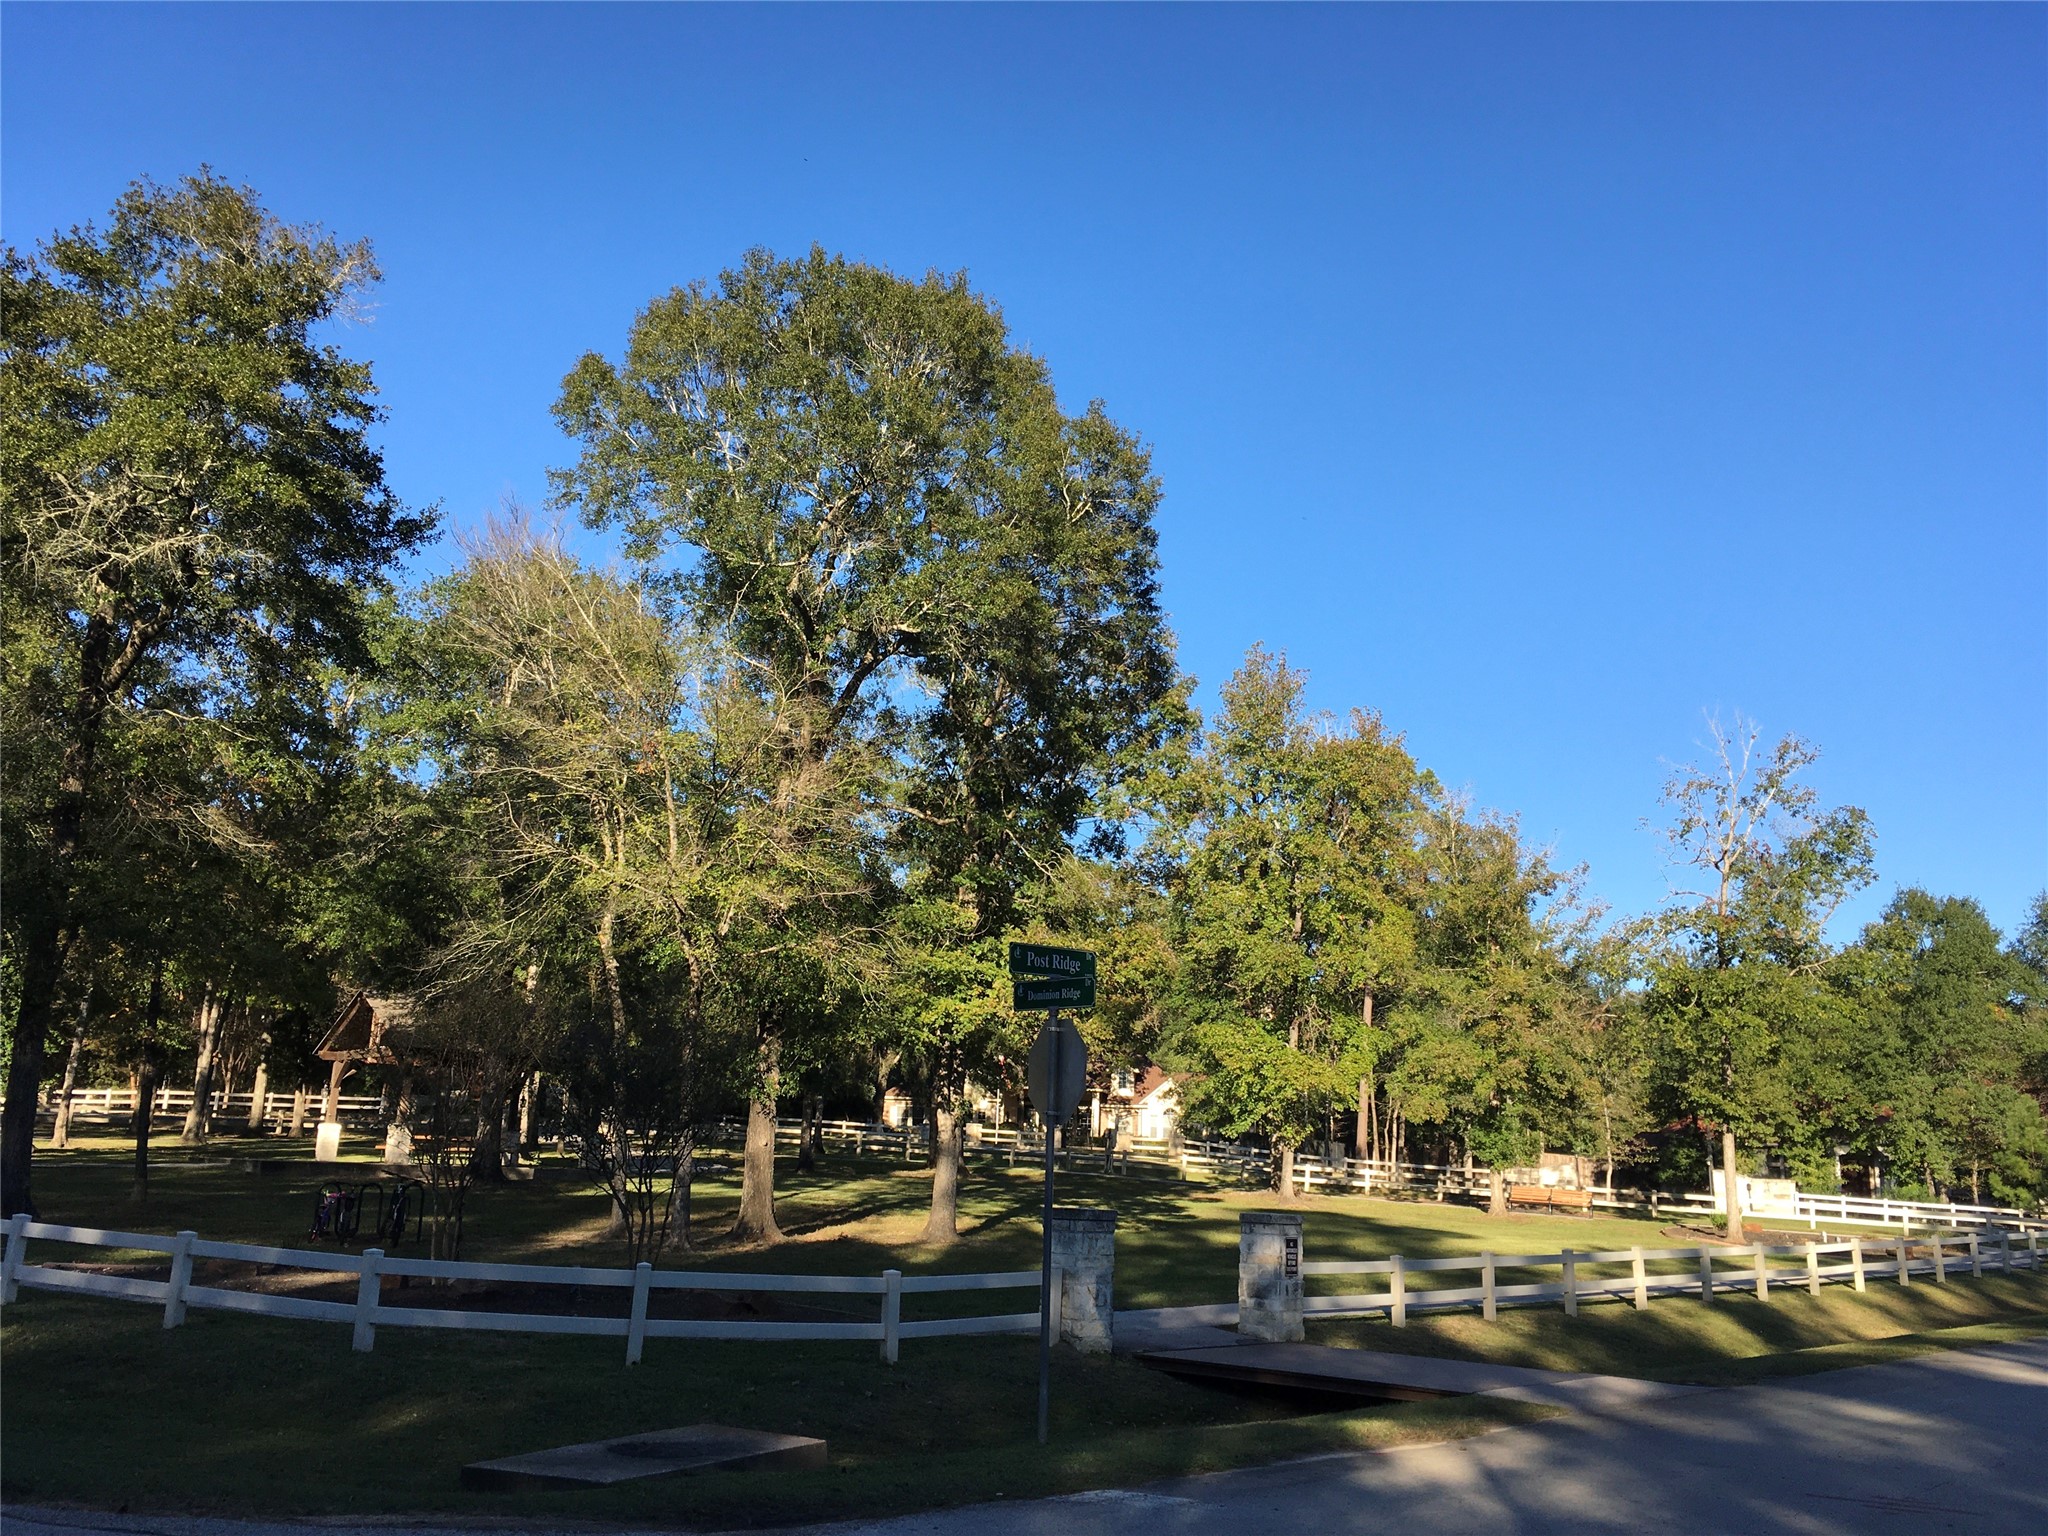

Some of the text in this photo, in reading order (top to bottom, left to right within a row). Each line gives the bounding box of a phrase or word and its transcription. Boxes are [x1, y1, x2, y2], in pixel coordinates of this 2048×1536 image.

[1027, 951, 1049, 968] Post
[1052, 954, 1081, 974] Ridge
[1028, 988, 1060, 1001] Dominion
[1061, 987, 1081, 1001] Ridge
